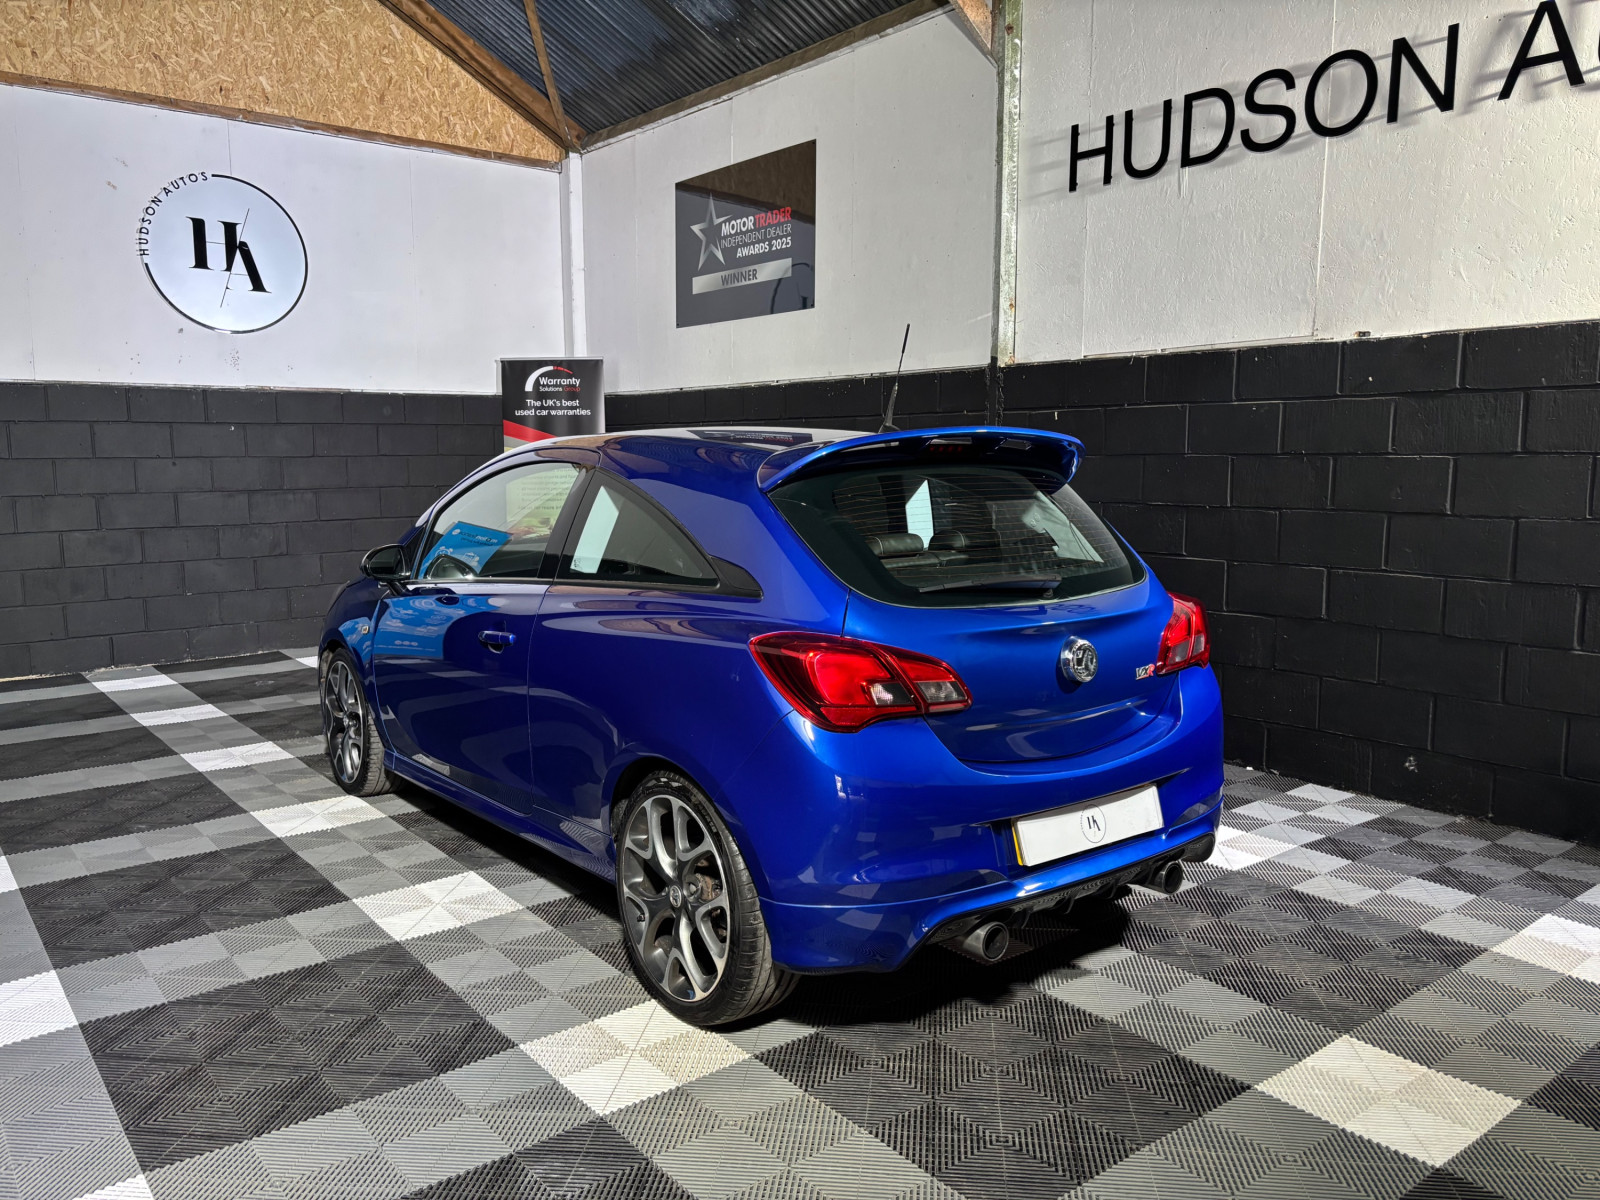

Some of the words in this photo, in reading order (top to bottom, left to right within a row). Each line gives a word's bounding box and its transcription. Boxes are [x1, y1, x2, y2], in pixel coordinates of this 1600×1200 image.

[1069, 23, 1460, 192] HUDSON
[1497, 0, 1600, 101] A
[138, 196, 163, 257] HUDSON
[163, 171, 208, 197] AUTOS
[721, 215, 754, 237] MOTOR
[755, 206, 792, 228] TRADER
[720, 229, 765, 249] INDEPENDENT
[766, 223, 792, 237] DEALER
[736, 242, 770, 259] AWARDS
[771, 236, 792, 251] 2025
[720, 268, 758, 286] WINNER
[538, 376, 581, 387] Warranty
[515, 408, 535, 416] used
[549, 408, 591, 416] warranties
[526, 399, 541, 407] The
[543, 399, 561, 407] UK's
[562, 399, 579, 407] best
[1135, 664, 1155, 680] VXR
